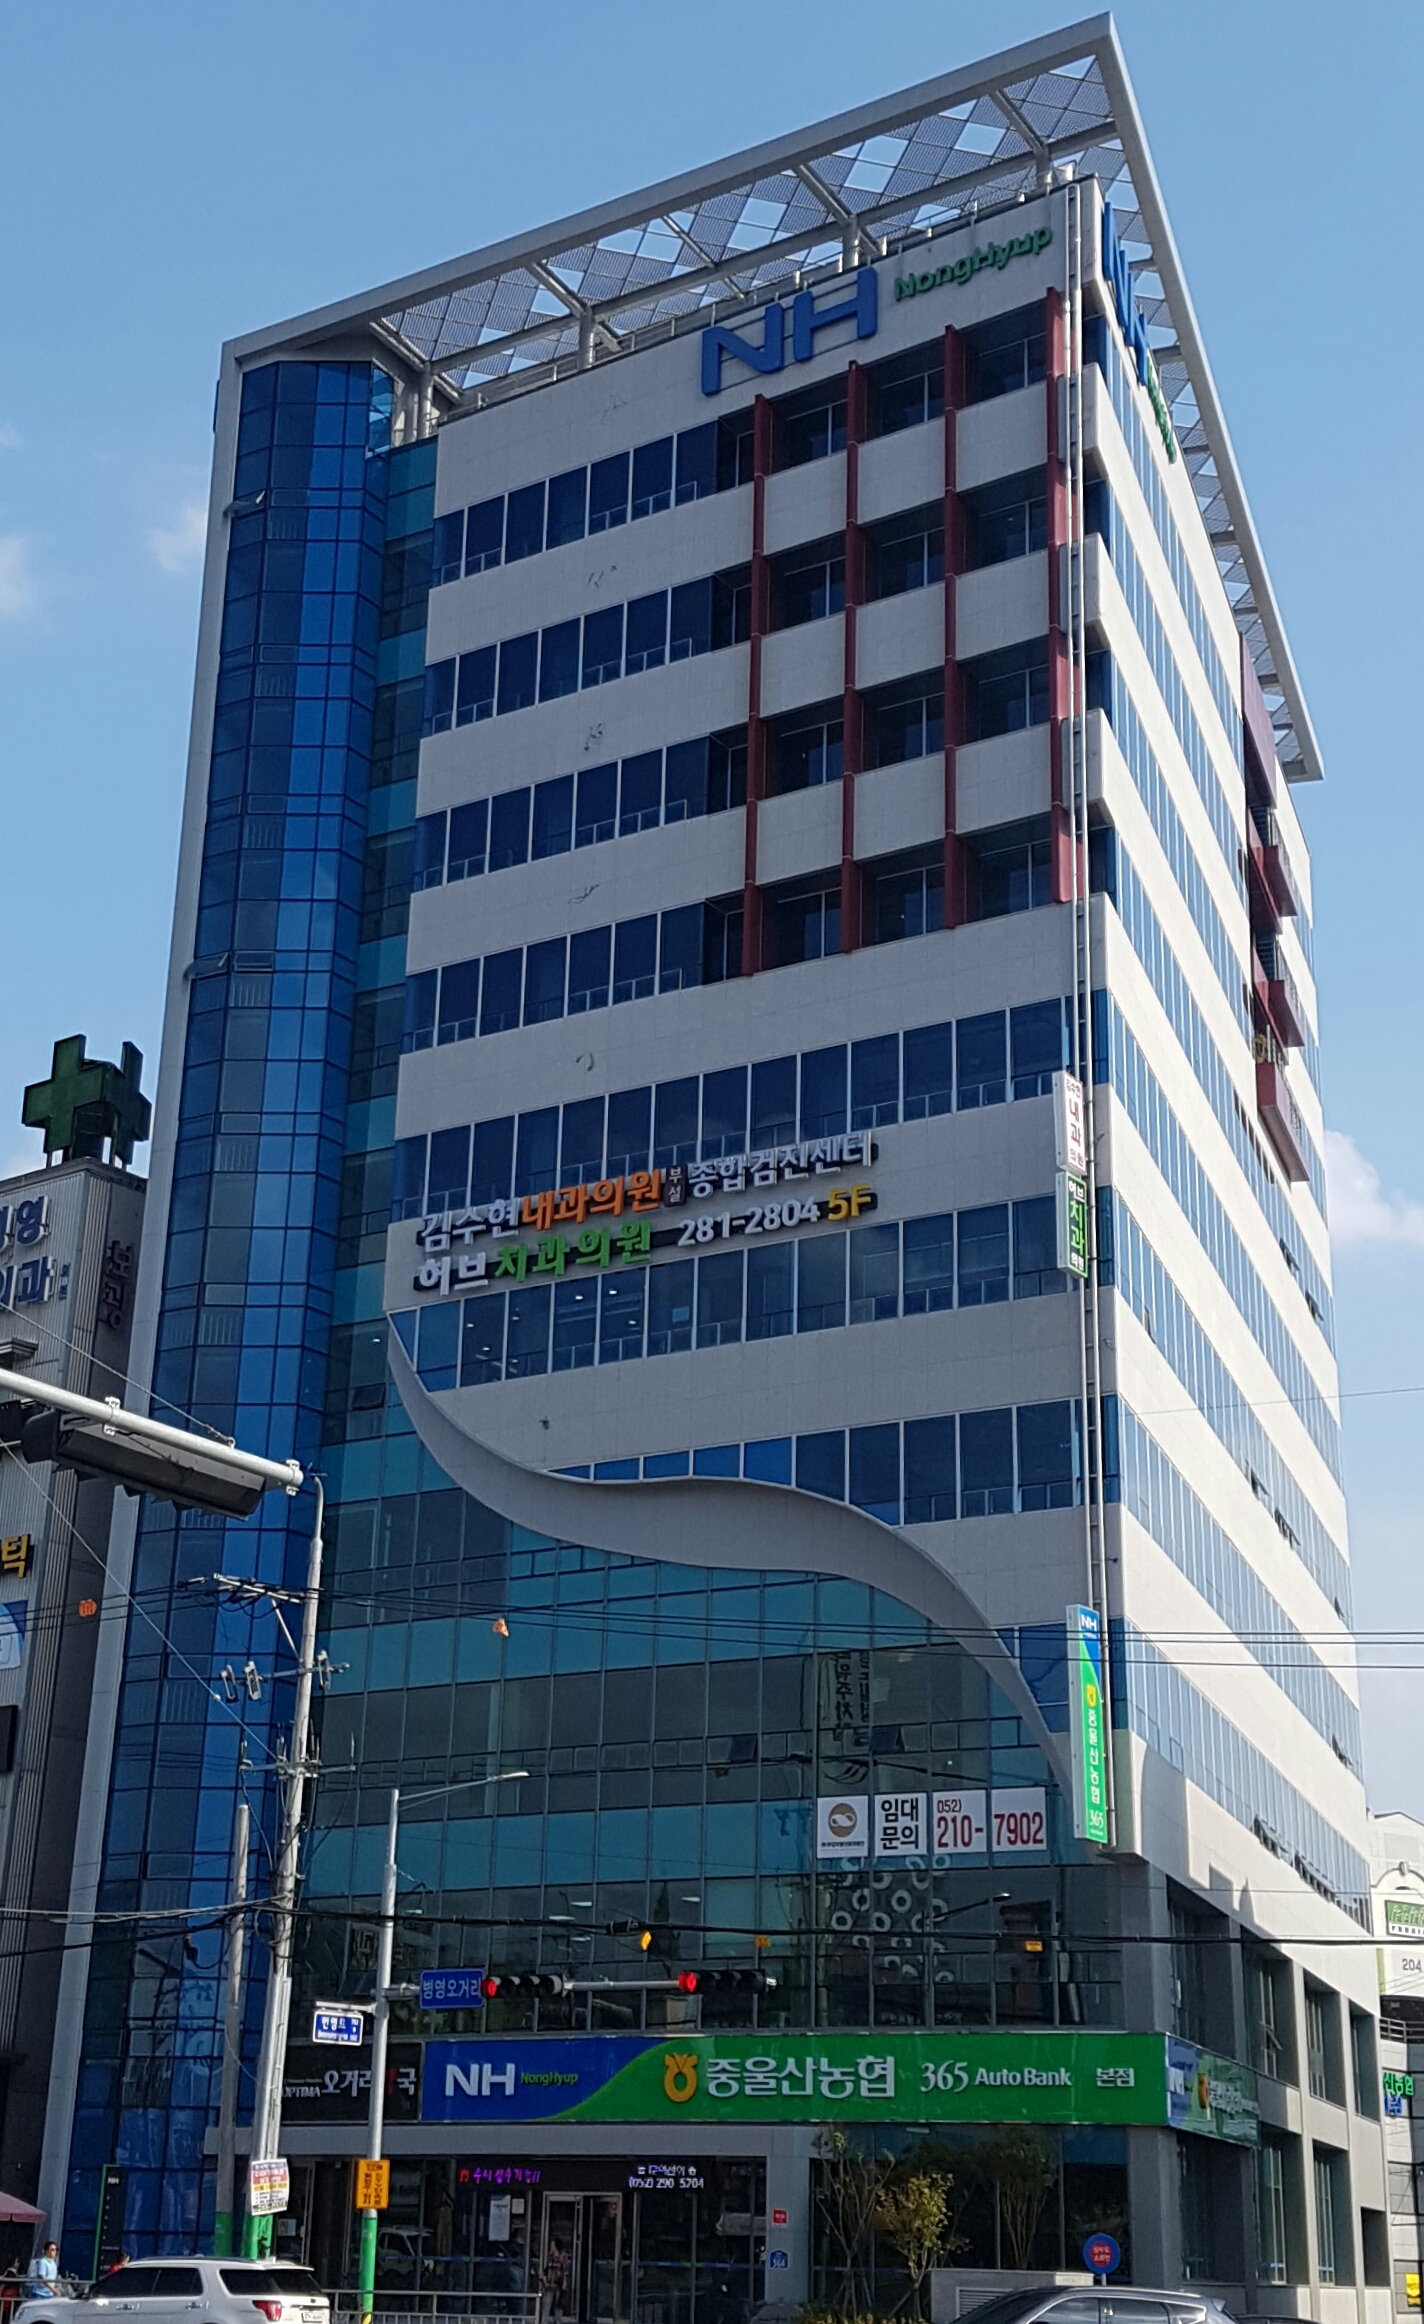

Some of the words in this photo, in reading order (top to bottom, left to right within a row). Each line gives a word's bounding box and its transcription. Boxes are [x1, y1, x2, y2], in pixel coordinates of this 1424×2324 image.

[701, 266, 879, 397] NH
[894, 226, 1053, 301] NongHyup
[668, 1166, 683, 1203] 부설
[688, 1130, 874, 1199] 종합검진센터
[1068, 1180, 1085, 1203] 허브
[0, 1195, 49, 1254] 영
[677, 1201, 821, 1248] 281-2804
[827, 1184, 874, 1222] 5F
[1069, 1199, 1085, 1257] 치과
[1080, 1613, 1098, 1632] NH
[880, 1797, 919, 1821] 임대
[936, 1798, 963, 1814] 052)
[880, 1824, 920, 1851] 문의
[936, 1814, 984, 1850] 210-
[993, 1811, 1045, 1847] 7902
[1402, 1958, 1423, 1973] 204
[422, 1976, 482, 2000] 병영오거리
[445, 2063, 516, 2097] NH
[520, 2071, 579, 2086] NongHyup
[705, 2055, 896, 2098] 중울산농협
[920, 2061, 969, 2093] 365
[974, 2067, 1021, 2087] Auto
[1024, 2067, 1072, 2087] Bank
[1096, 2067, 1135, 2088] 본점
